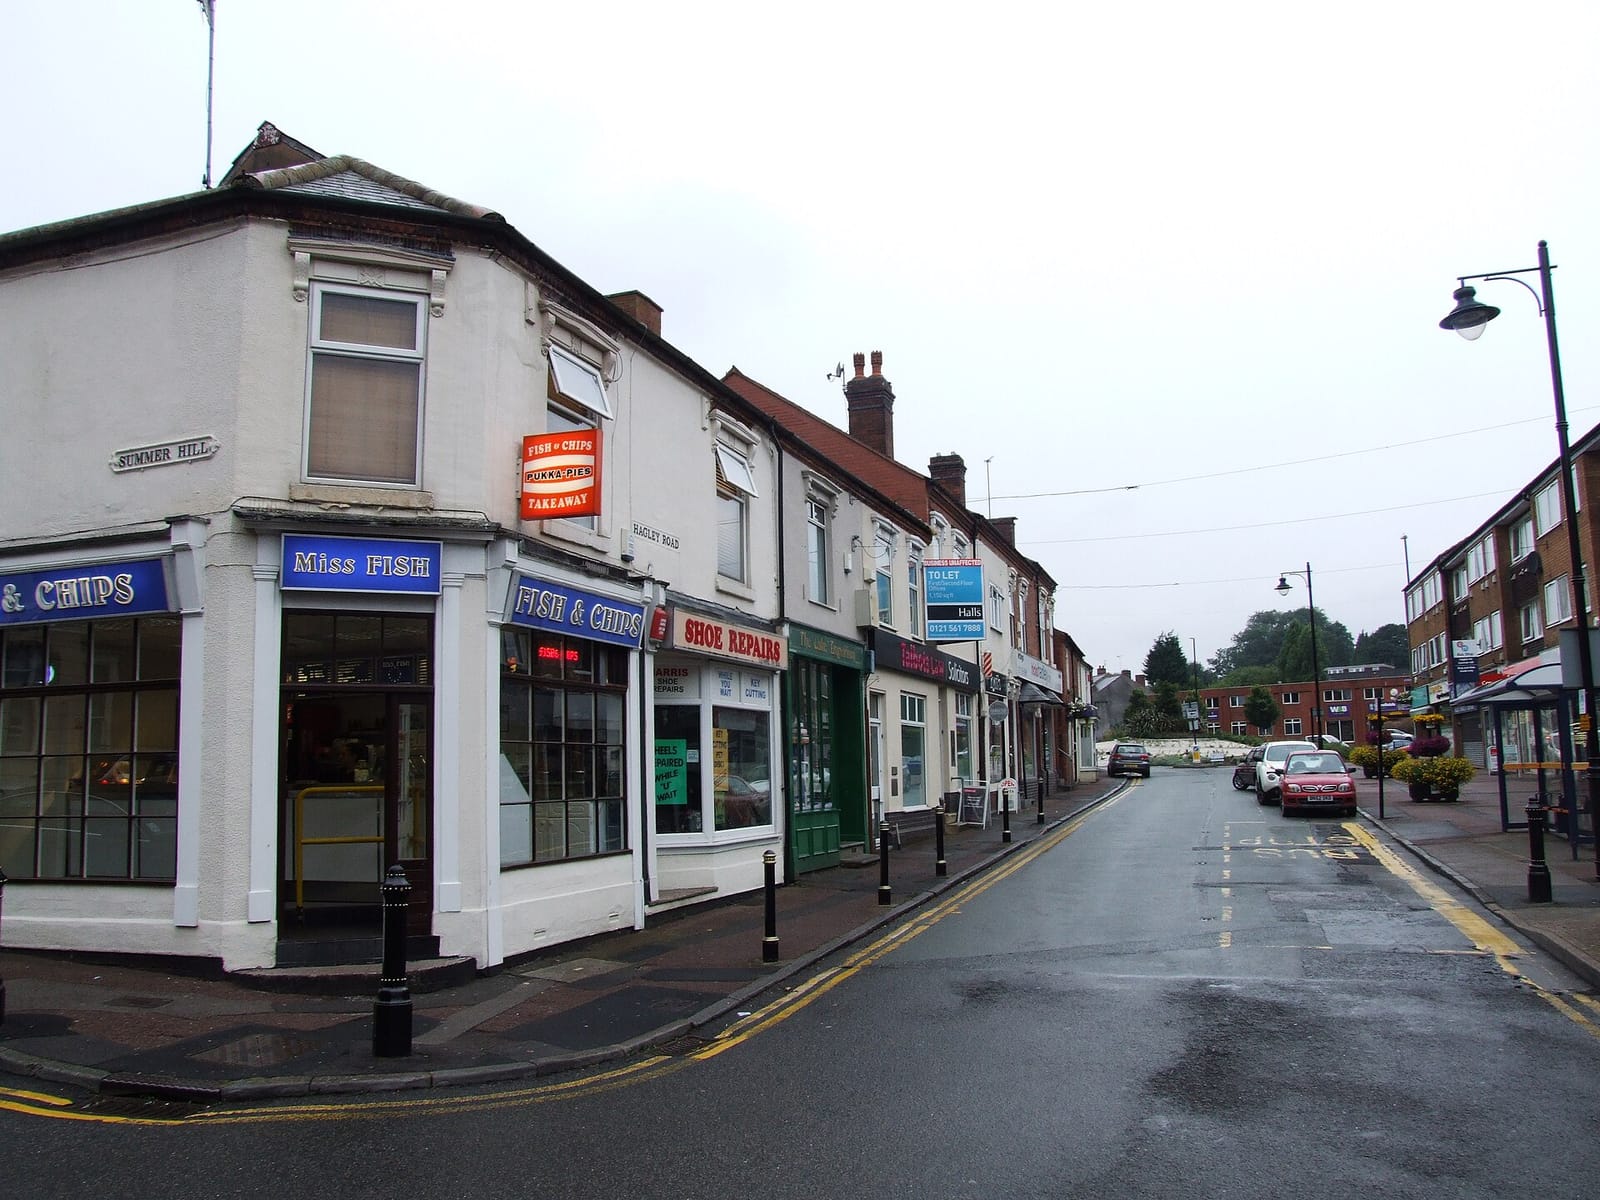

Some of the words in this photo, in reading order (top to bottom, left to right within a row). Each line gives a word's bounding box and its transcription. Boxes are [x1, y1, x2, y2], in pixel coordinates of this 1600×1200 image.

[119, 448, 171, 468] SUMMER
[177, 441, 209, 458] HILL
[528, 443, 552, 457] FISH
[561, 440, 593, 451] CHIPS
[526, 466, 592, 481] PUKKA-PIES
[528, 493, 588, 509] TAKEAWAY
[633, 523, 661, 544] HAGLEY
[662, 534, 680, 550] ROAD
[293, 552, 356, 575] Miss
[366, 555, 431, 578] FISH
[928, 571, 941, 580] TO
[942, 571, 960, 580] LET
[1, 583, 25, 613] &
[35, 573, 135, 611] CHIPS
[515, 585, 568, 623] FISH
[570, 599, 585, 626] &
[590, 603, 642, 638] CHIPS
[958, 607, 982, 618] Halls
[929, 625, 948, 633] 0121
[948, 624, 962, 633] 561
[685, 618, 722, 650] SHOE
[729, 629, 780, 662] REPAIRS
[655, 668, 688, 677] ARRIS
[946, 660, 969, 686] Solicitors
[657, 677, 679, 685] SHOE
[720, 680, 731, 688] YOU
[750, 678, 761, 688] KEY
[720, 688, 732, 697] WAIT
[745, 688, 767, 699] CUTTING
[657, 789, 678, 801] WAIT
